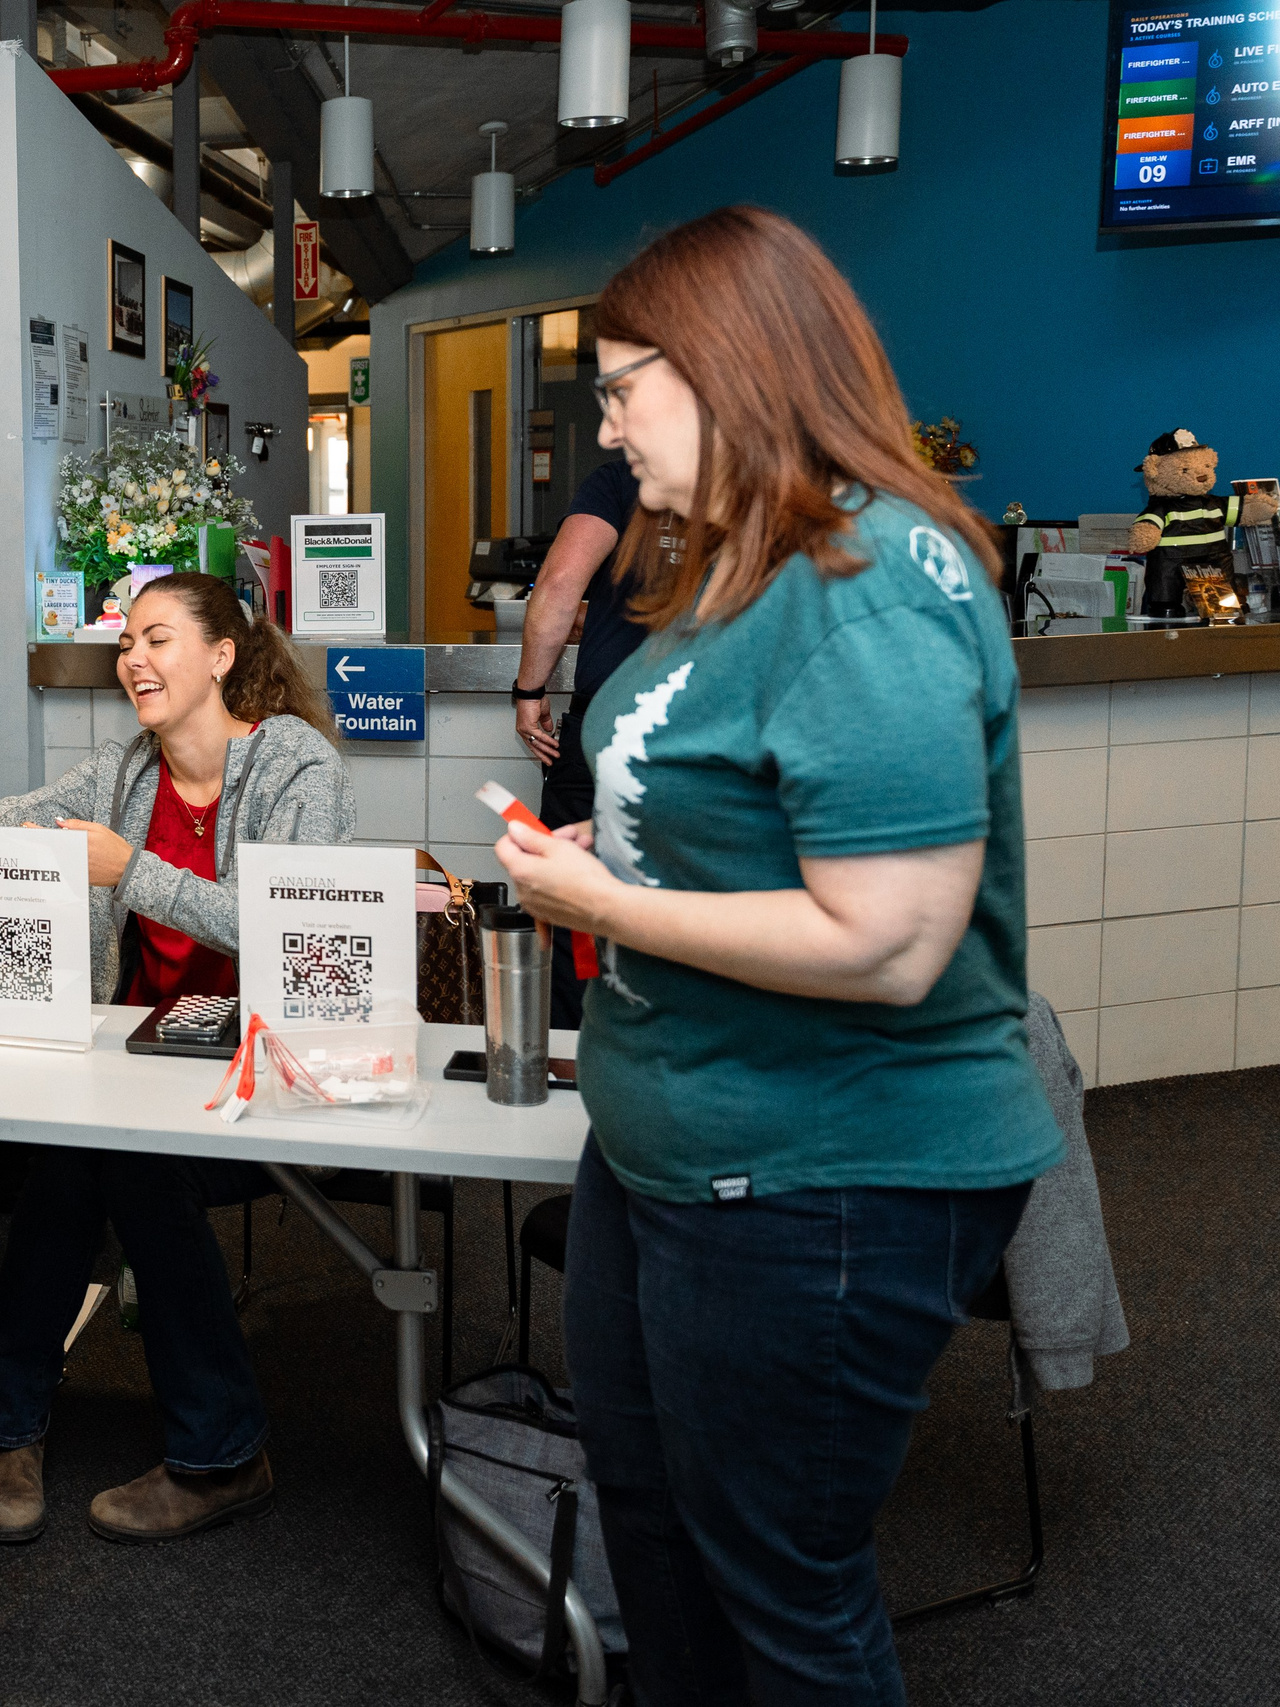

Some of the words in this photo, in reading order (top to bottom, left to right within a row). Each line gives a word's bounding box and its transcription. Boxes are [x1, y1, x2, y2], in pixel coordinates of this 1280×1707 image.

[1130, 20, 1182, 33] TODAY'S
[1186, 14, 1244, 28] TRAINING
[1234, 46, 1264, 57] LIVE
[1128, 58, 1180, 68] FIREFIGHTER
[1231, 82, 1269, 94] AUTO
[1126, 94, 1178, 104] FIREFIGHTER
[1229, 118, 1264, 130] ARFF
[1123, 130, 1176, 139] FIREFIGHTER
[1140, 155, 1167, 163] EMR-W
[1227, 155, 1256, 166] EMR
[1139, 164, 1166, 183] 09
[299, 232, 313, 242] FIRE
[352, 361, 369, 370] FIRST
[355, 386, 365, 396] AID
[304, 537, 372, 545] Black&McDonald
[348, 693, 403, 710] Water
[335, 714, 417, 731] Fountain
[269, 876, 336, 888] CANADIAN
[269, 887, 384, 903] FIREFIGHTER
[719, 1188, 746, 1200] COAST
